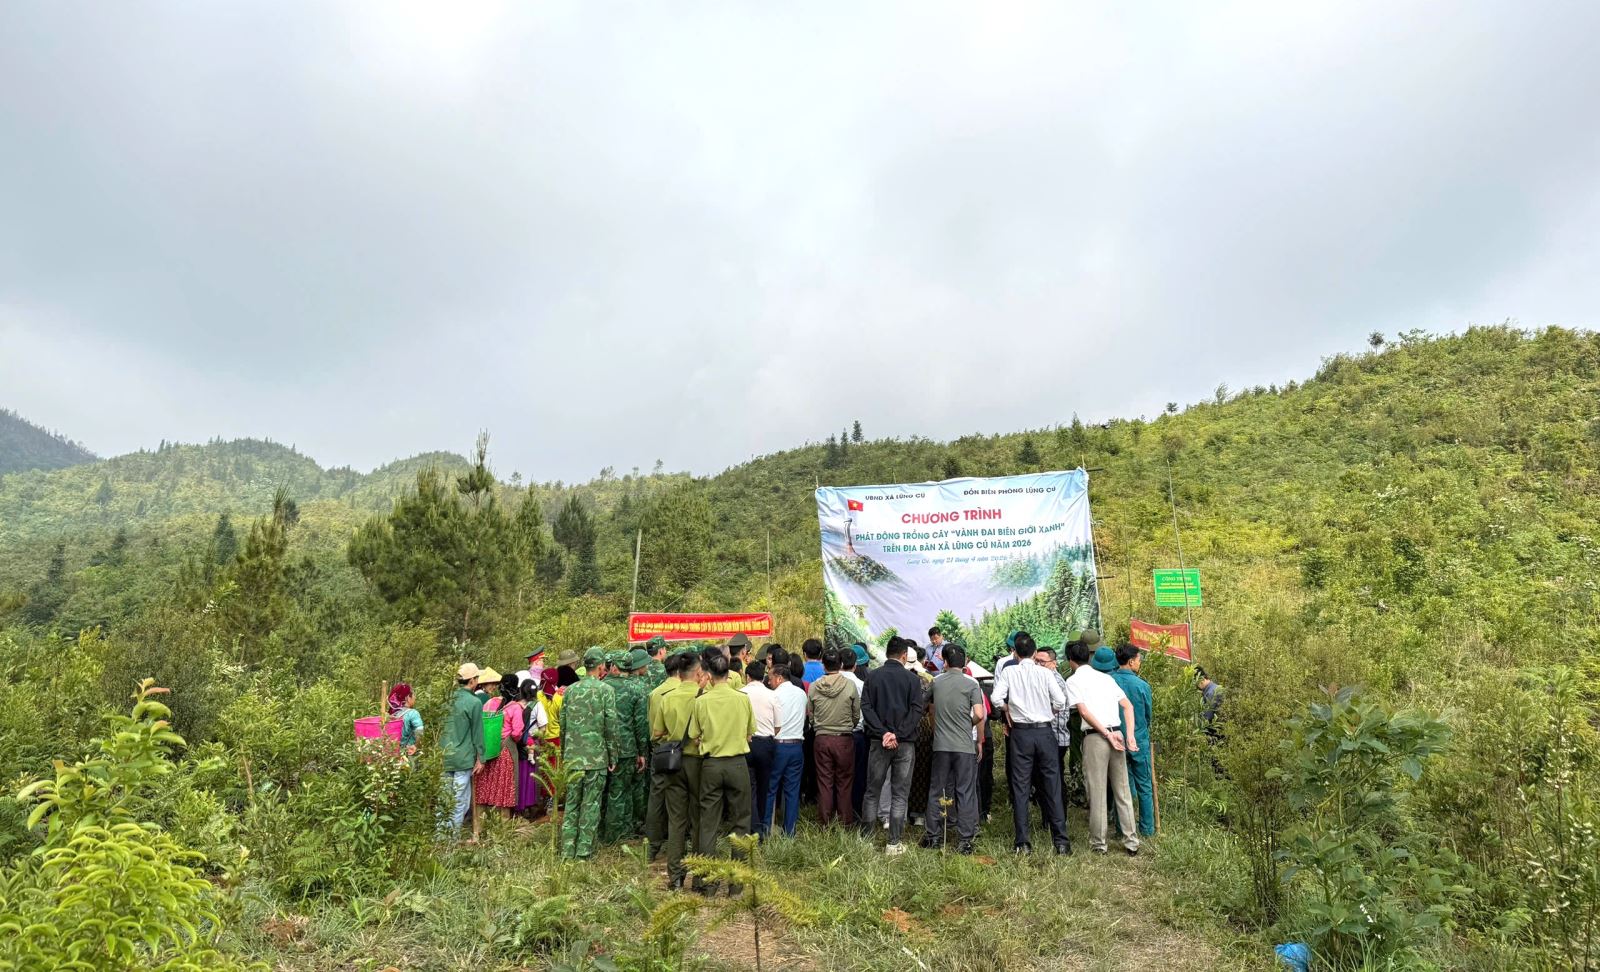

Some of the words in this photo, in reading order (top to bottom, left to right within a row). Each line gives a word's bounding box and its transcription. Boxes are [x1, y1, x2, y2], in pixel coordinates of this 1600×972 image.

[998, 487, 1024, 495] PHÒNG
[1025, 486, 1044, 494] LŨNG
[901, 511, 960, 524] CHƯƠNG
[963, 506, 1002, 521] TRÌNH
[855, 531, 874, 541] PHÁT
[876, 531, 900, 541] ĐỘNG
[902, 529, 930, 540] TRỒNG
[932, 530, 949, 539] CÂY
[981, 528, 996, 536] ĐAI
[998, 526, 1016, 536] BIÊN
[1018, 525, 1037, 535] GIỚI
[883, 544, 901, 553] TRÊN
[903, 544, 917, 554] ĐỊA
[919, 542, 936, 552] BÀN
[938, 541, 950, 551] XÃ
[952, 541, 974, 550] LŨNG
[976, 540, 988, 549] CÚ
[990, 540, 1010, 549] NĂM
[1012, 539, 1032, 548] 2026
